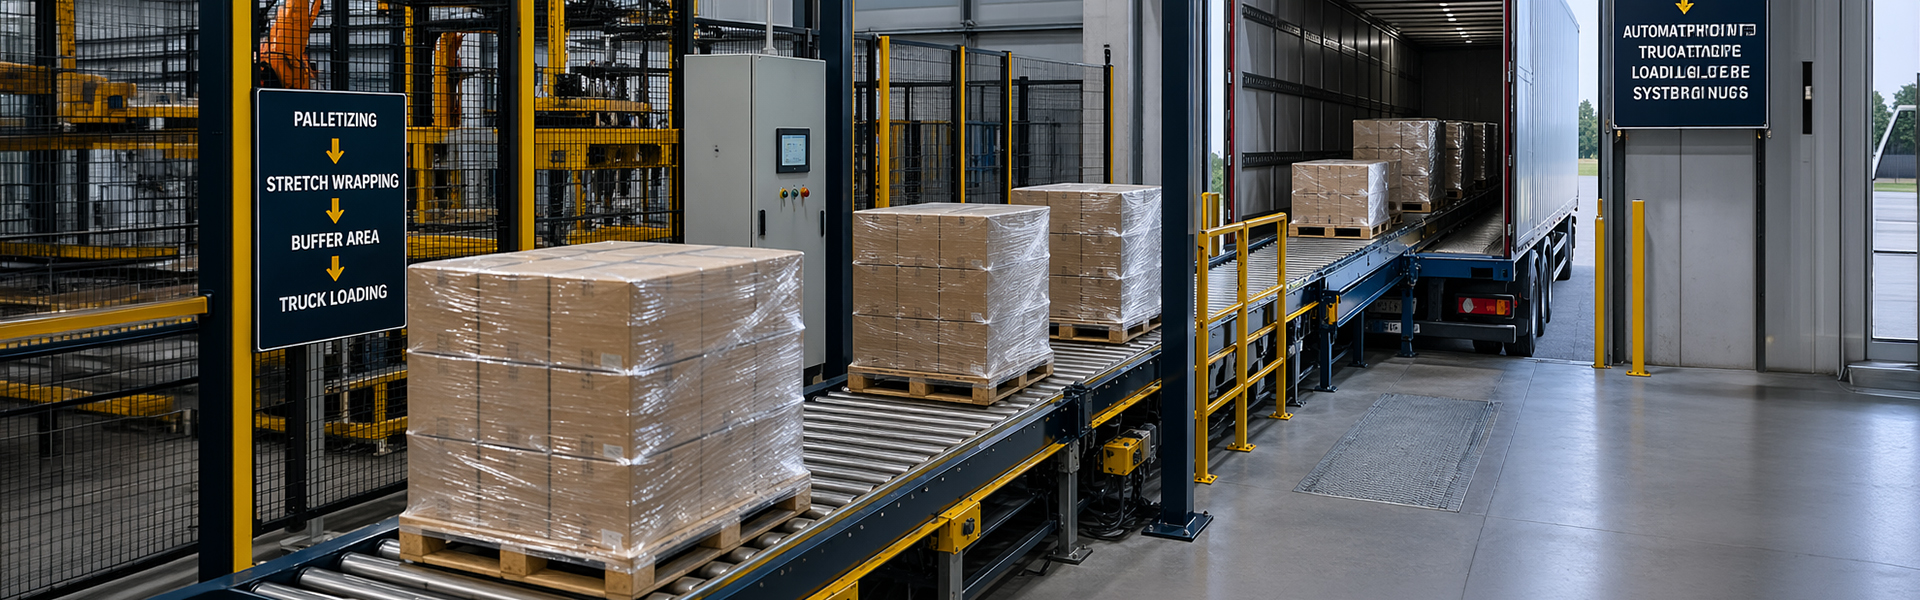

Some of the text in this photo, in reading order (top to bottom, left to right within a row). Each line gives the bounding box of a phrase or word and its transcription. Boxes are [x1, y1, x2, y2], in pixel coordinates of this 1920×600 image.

[294, 111, 377, 128] PALLETIZING
[266, 173, 399, 192] STRETCH WRAPPING
[291, 229, 380, 251] BUFFER AREA
[279, 284, 388, 312] TRUCK LOADING
